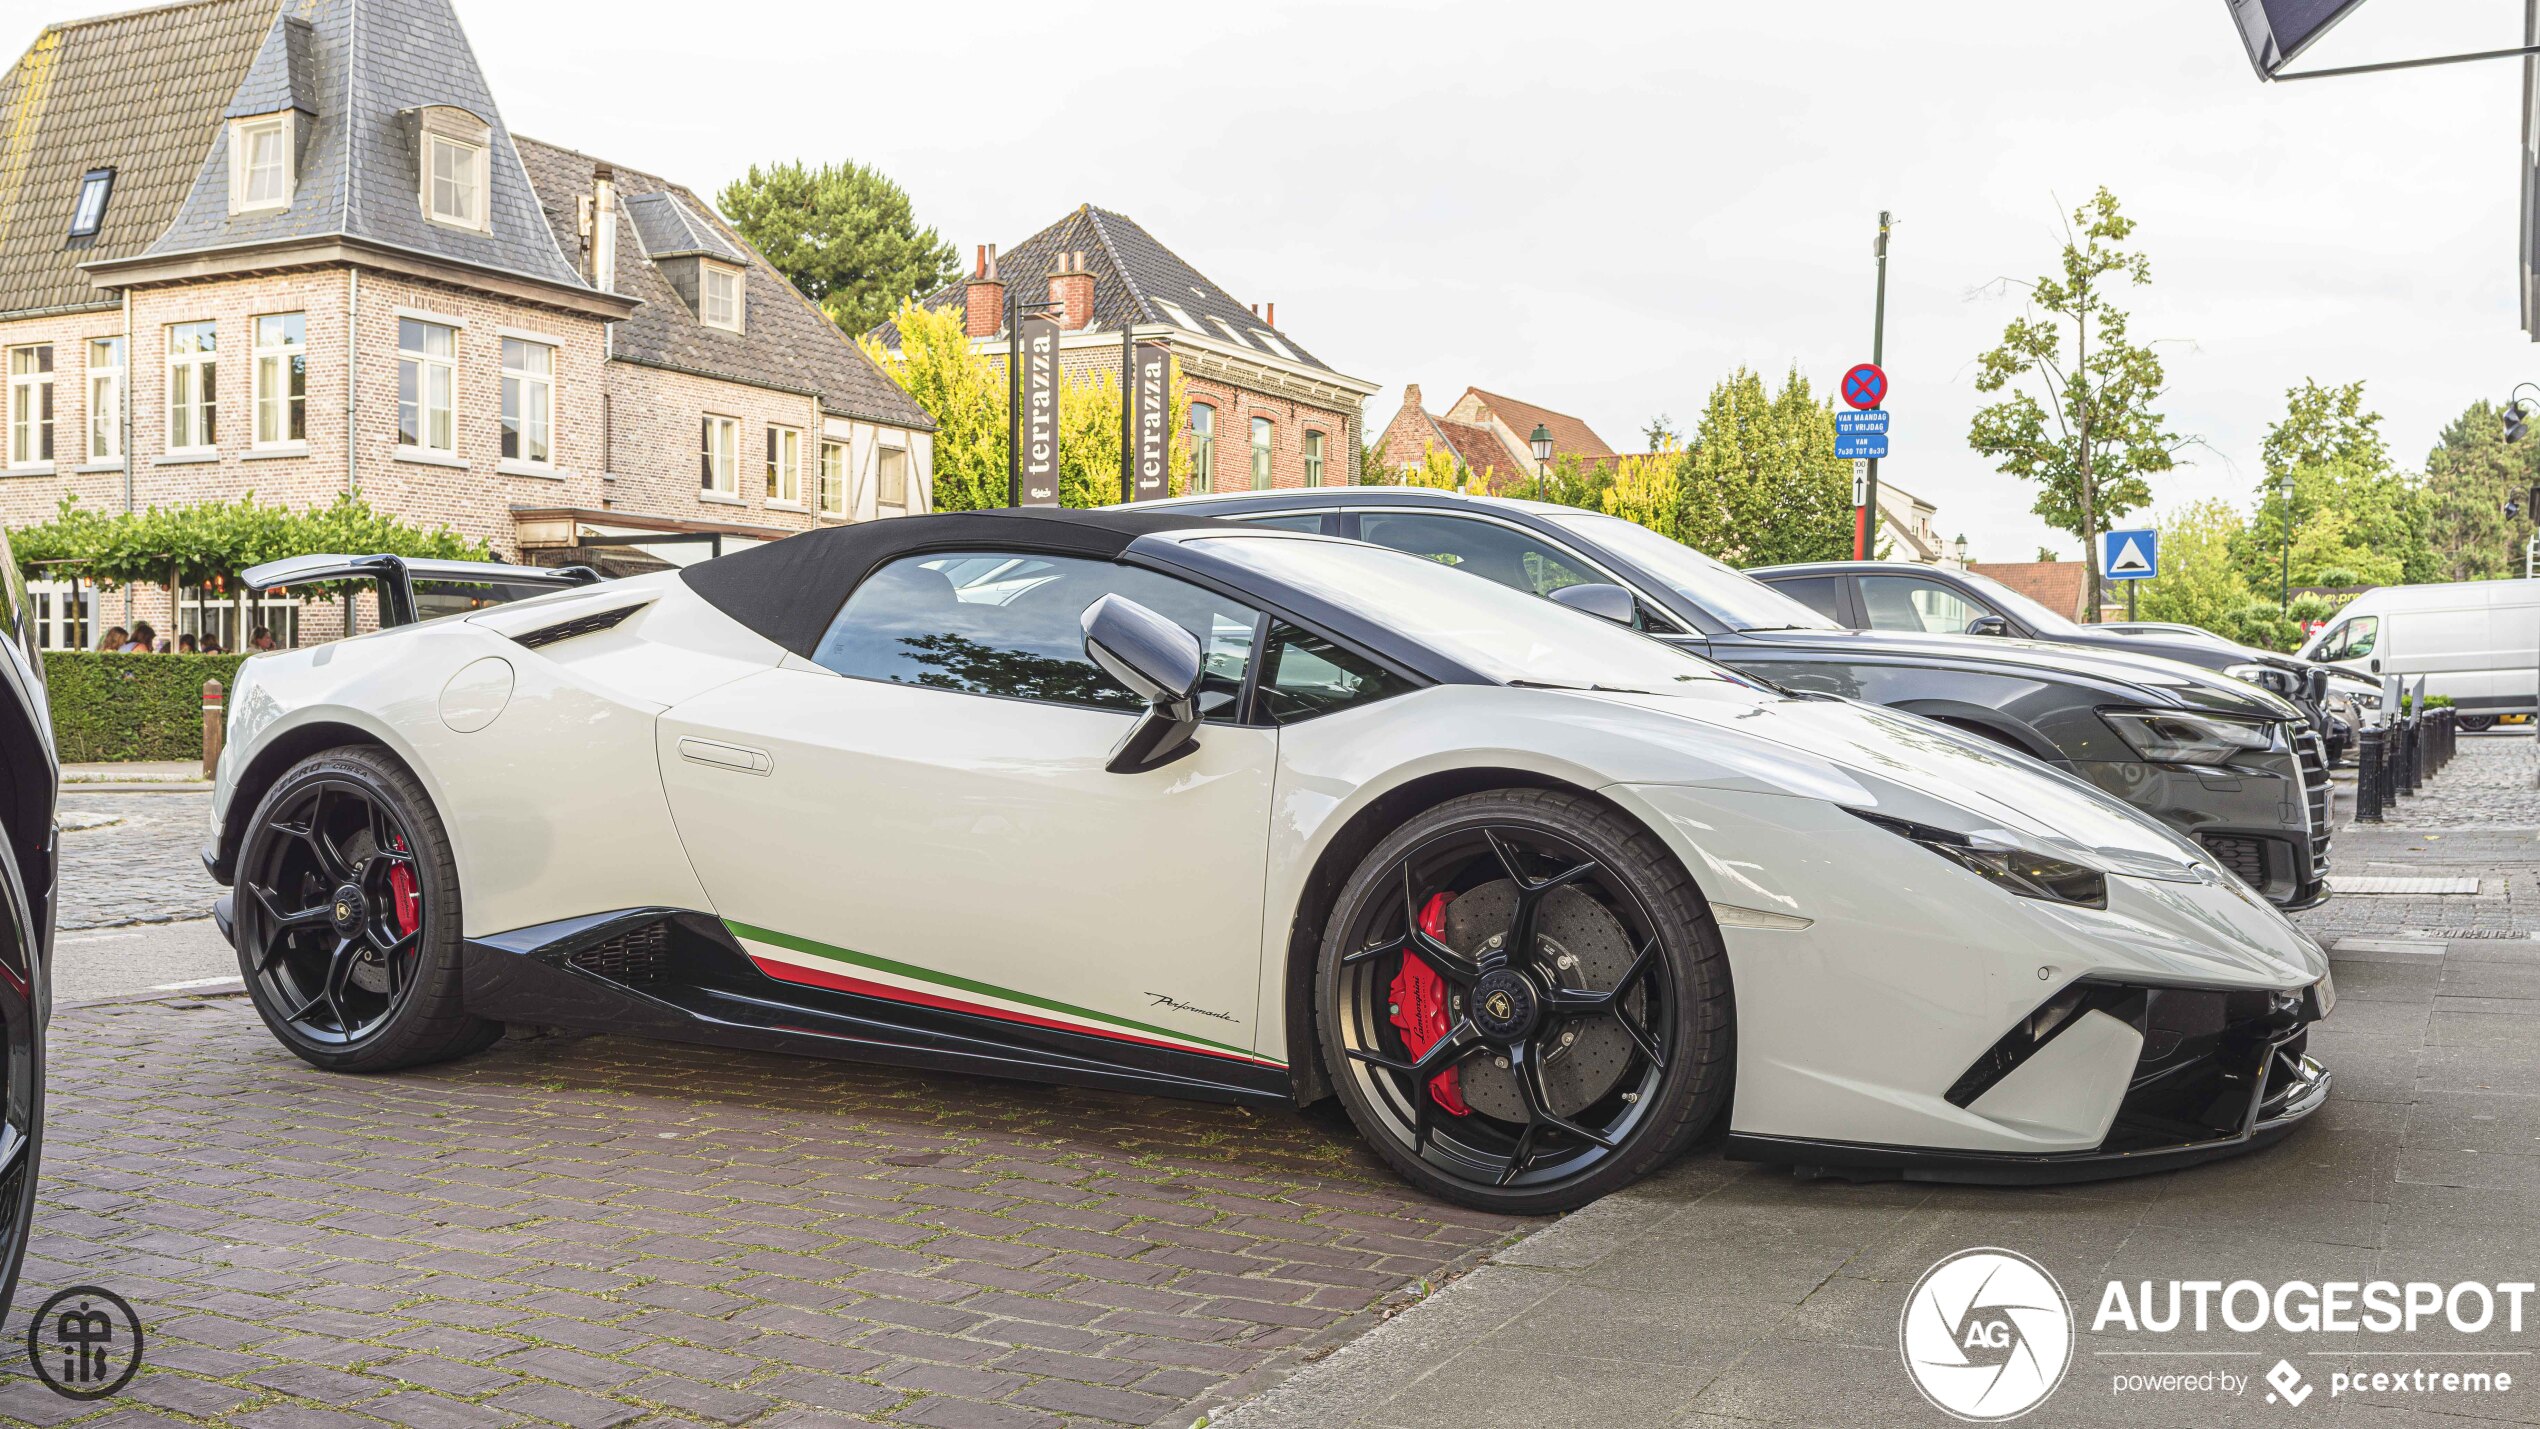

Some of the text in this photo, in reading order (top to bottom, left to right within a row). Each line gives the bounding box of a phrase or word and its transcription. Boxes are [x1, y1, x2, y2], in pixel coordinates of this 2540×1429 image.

[1855, 423, 1884, 431] VRIJDAG
[332, 763, 368, 778] CORSA
[1143, 991, 1240, 1024] Performante
[1412, 975, 1425, 1044] Lamborghini
